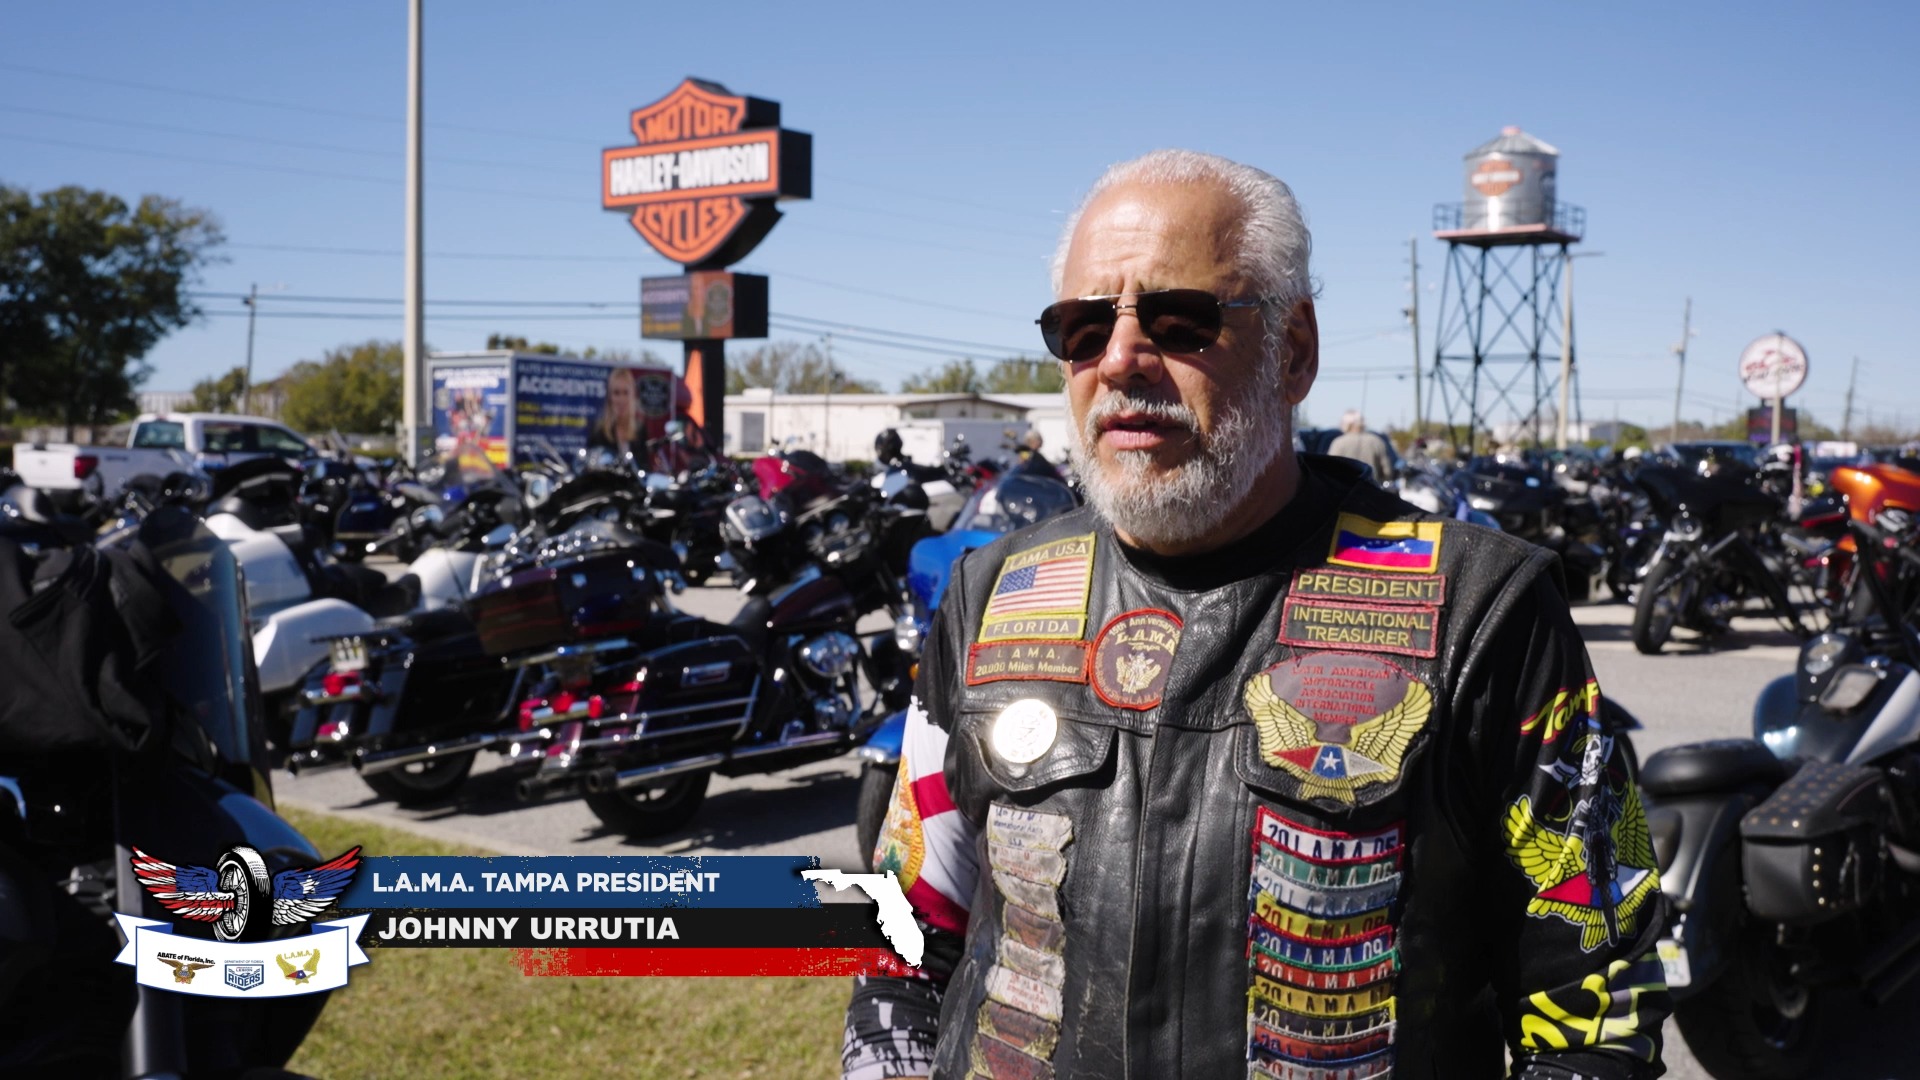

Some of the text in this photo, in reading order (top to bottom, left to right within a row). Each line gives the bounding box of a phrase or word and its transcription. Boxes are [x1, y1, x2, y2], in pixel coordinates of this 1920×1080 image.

[645, 96, 731, 143] MOTOR
[609, 141, 769, 197] HARLEY-DAVIDSON
[645, 197, 730, 250] CYCLES
[518, 375, 607, 398] ACCIDENTS
[1009, 542, 1086, 569] LAMA USA
[1298, 574, 1439, 597] PRESIDENT
[992, 619, 1070, 634] FLORIDA
[1293, 606, 1431, 630] INTERNATIONAL
[1305, 625, 1409, 647] TREASURER
[1007, 661, 1034, 672] Miles
[1037, 661, 1079, 674] Member
[1331, 667, 1390, 679] AMERICAN
[1301, 688, 1375, 702] ASSOCIATION
[1302, 677, 1376, 690] MOTORCYCLE
[1362, 938, 1383, 961] 09
